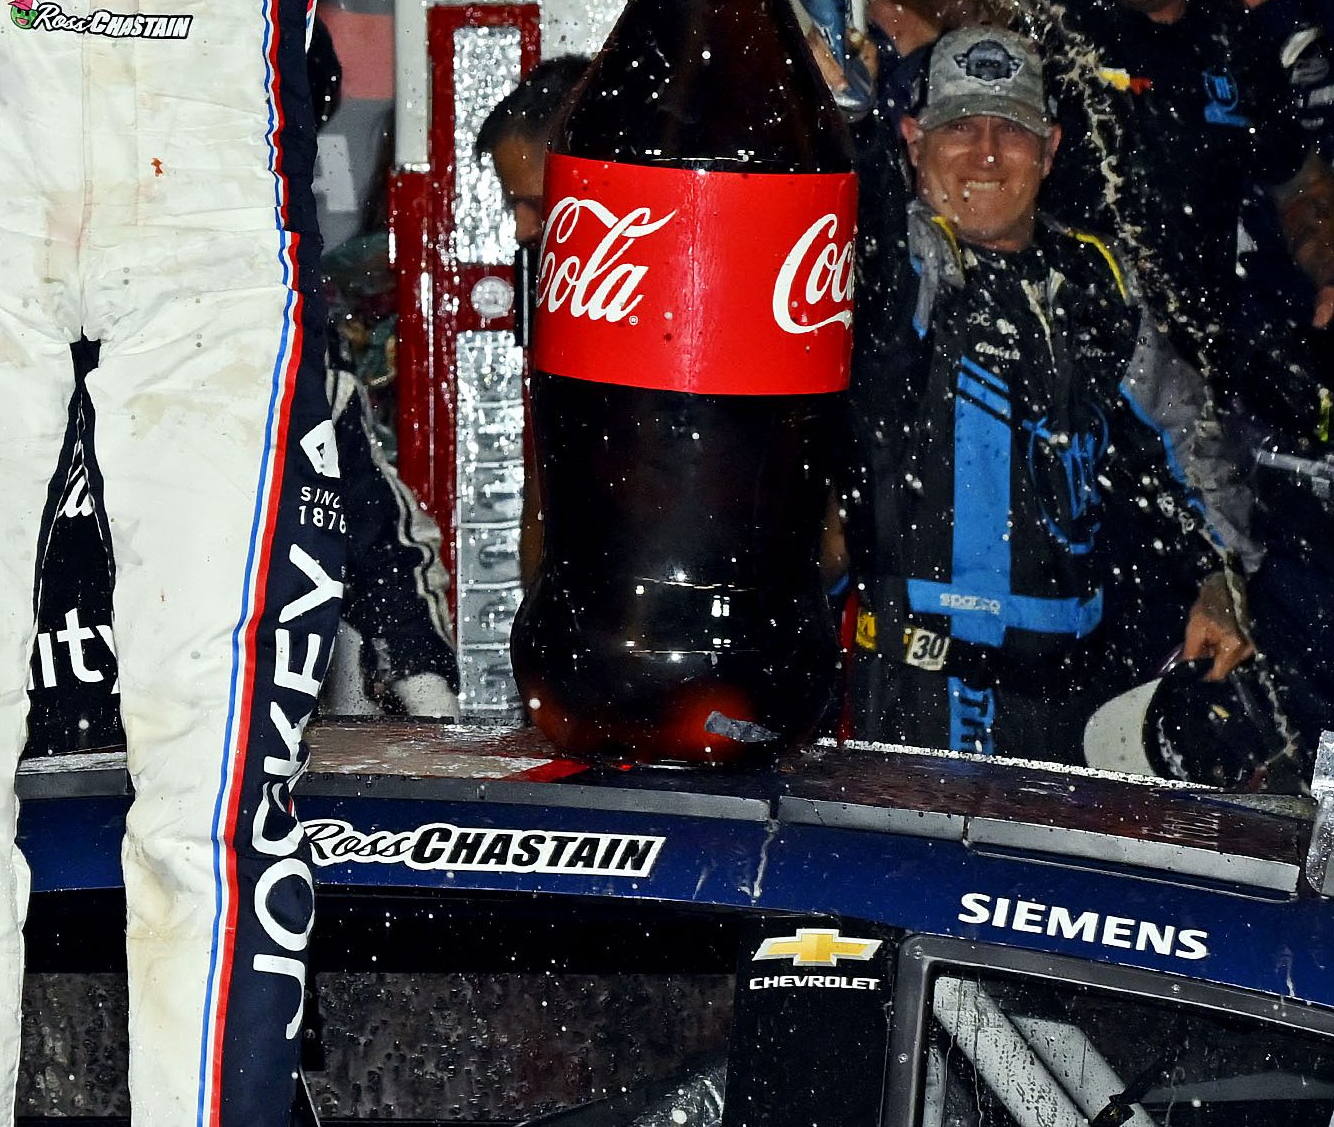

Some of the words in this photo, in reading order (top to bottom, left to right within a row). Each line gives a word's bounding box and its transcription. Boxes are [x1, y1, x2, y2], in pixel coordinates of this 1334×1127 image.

[89, 11, 192, 37] CHASTAIN
[913, 634, 946, 661] 30
[410, 827, 657, 872] CHASTAIN
[957, 892, 1209, 961] SIEMENS
[749, 975, 880, 991] CHEVROLET
